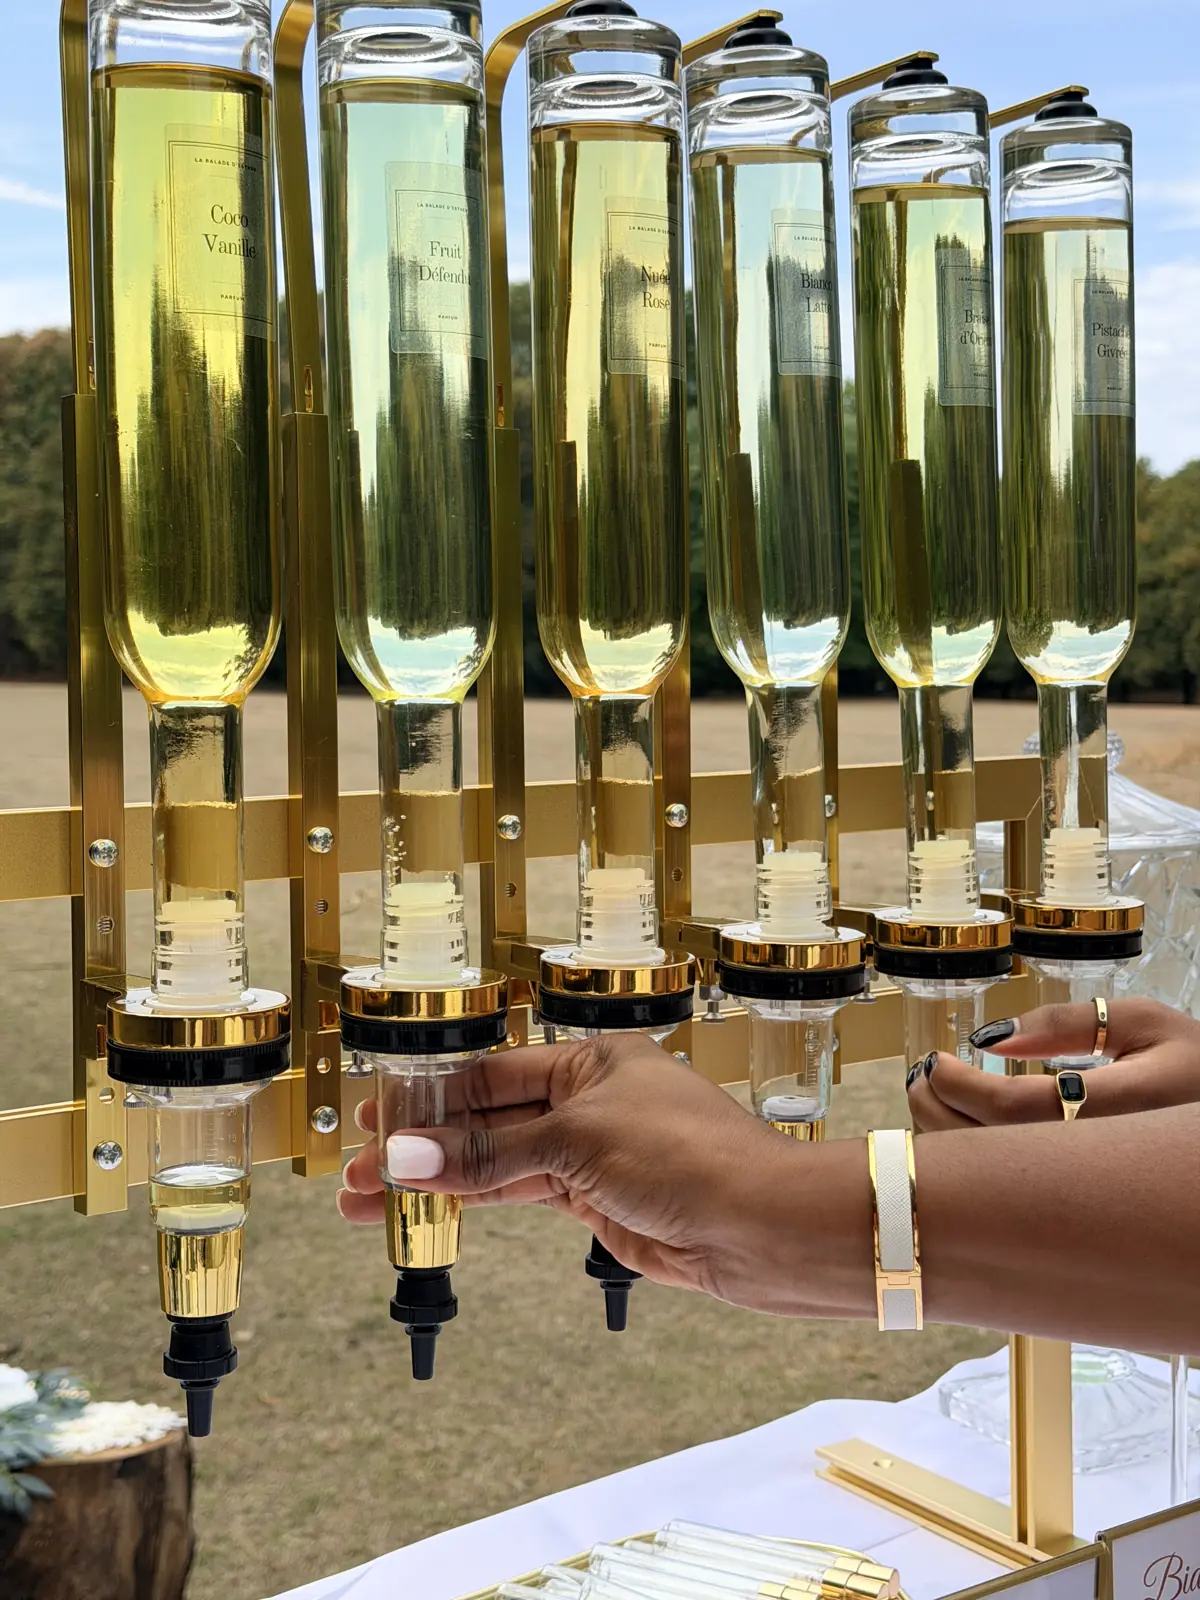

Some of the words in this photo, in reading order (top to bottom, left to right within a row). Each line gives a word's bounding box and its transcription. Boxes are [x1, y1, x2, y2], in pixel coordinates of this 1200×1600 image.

[210, 204, 249, 228] Coco
[202, 233, 256, 259] Vanille
[428, 240, 462, 260] Fruit
[418, 265, 472, 286] Défendu
[642, 291, 671, 311] Rose
[806, 297, 832, 314] Latte
